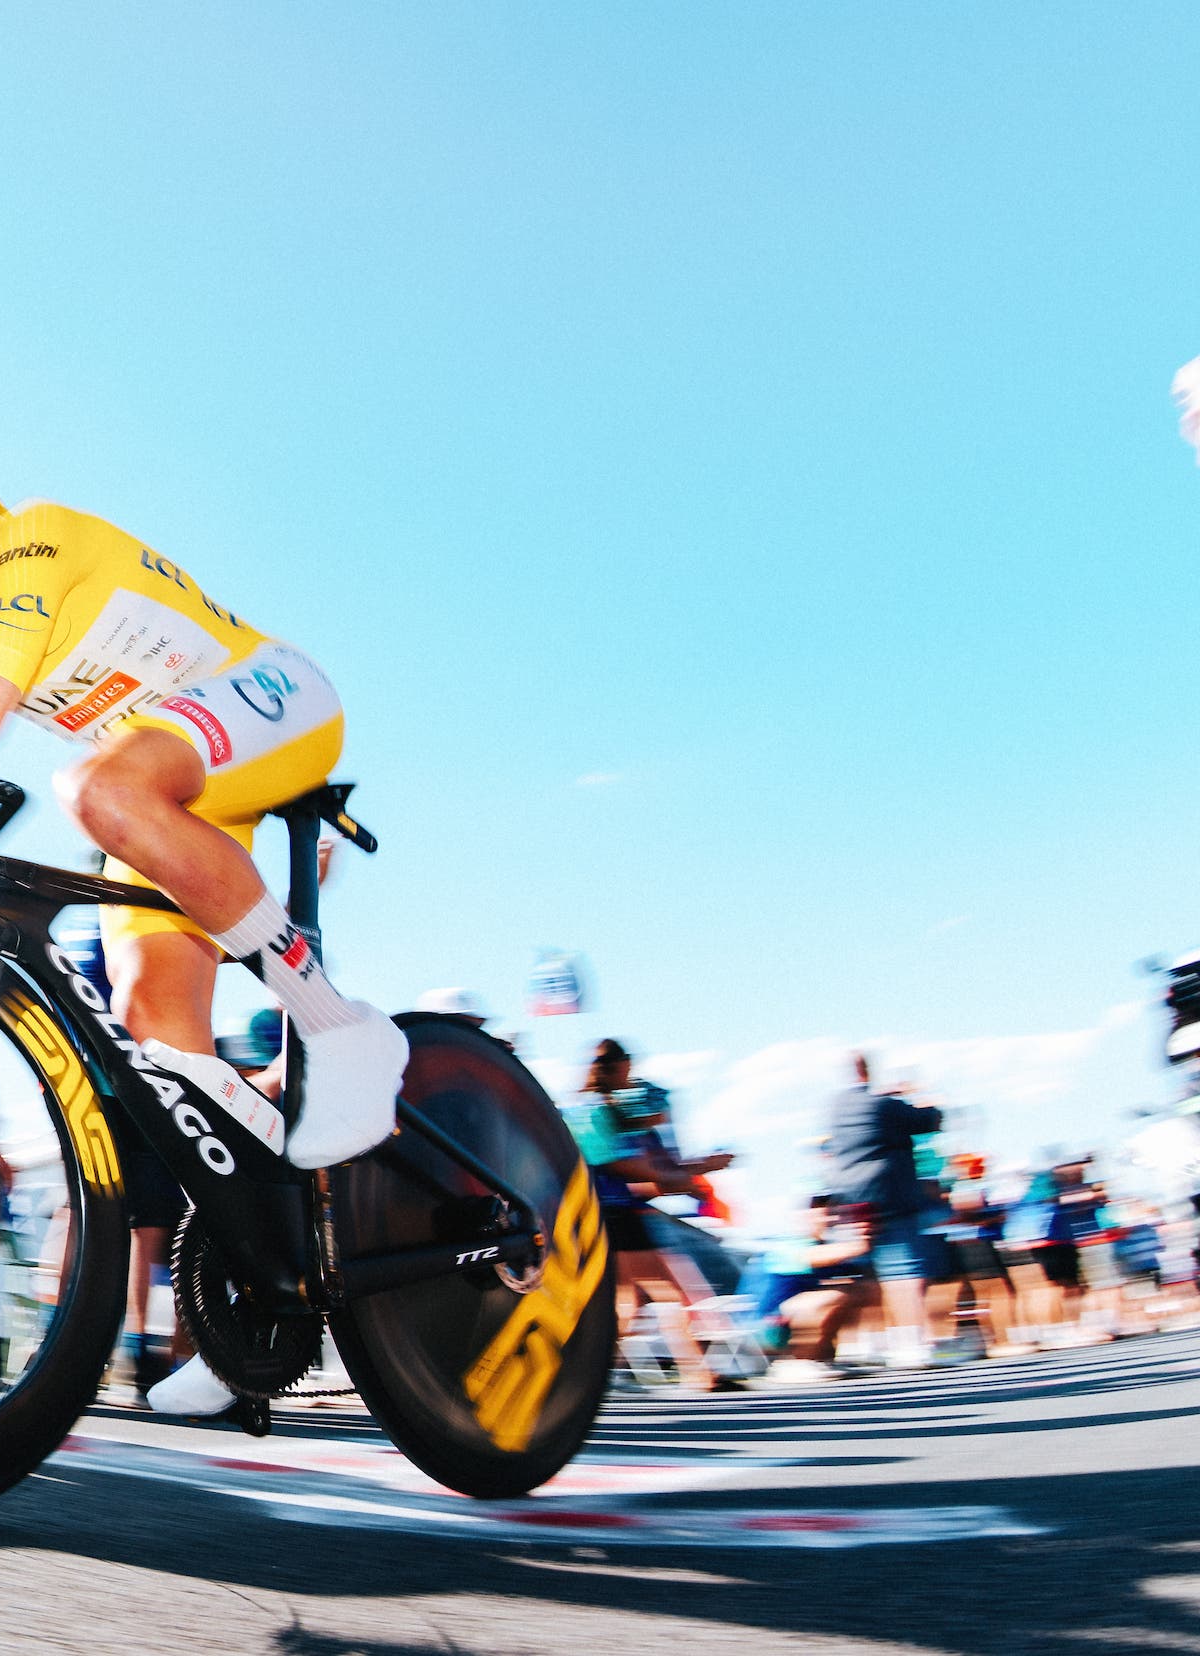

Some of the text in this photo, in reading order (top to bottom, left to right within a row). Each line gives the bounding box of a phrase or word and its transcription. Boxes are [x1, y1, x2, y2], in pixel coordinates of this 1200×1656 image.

[140, 549, 188, 591] LCL
[18, 659, 112, 716] UAE
[62, 681, 126, 726] Emirates
[168, 700, 225, 758] Emirates
